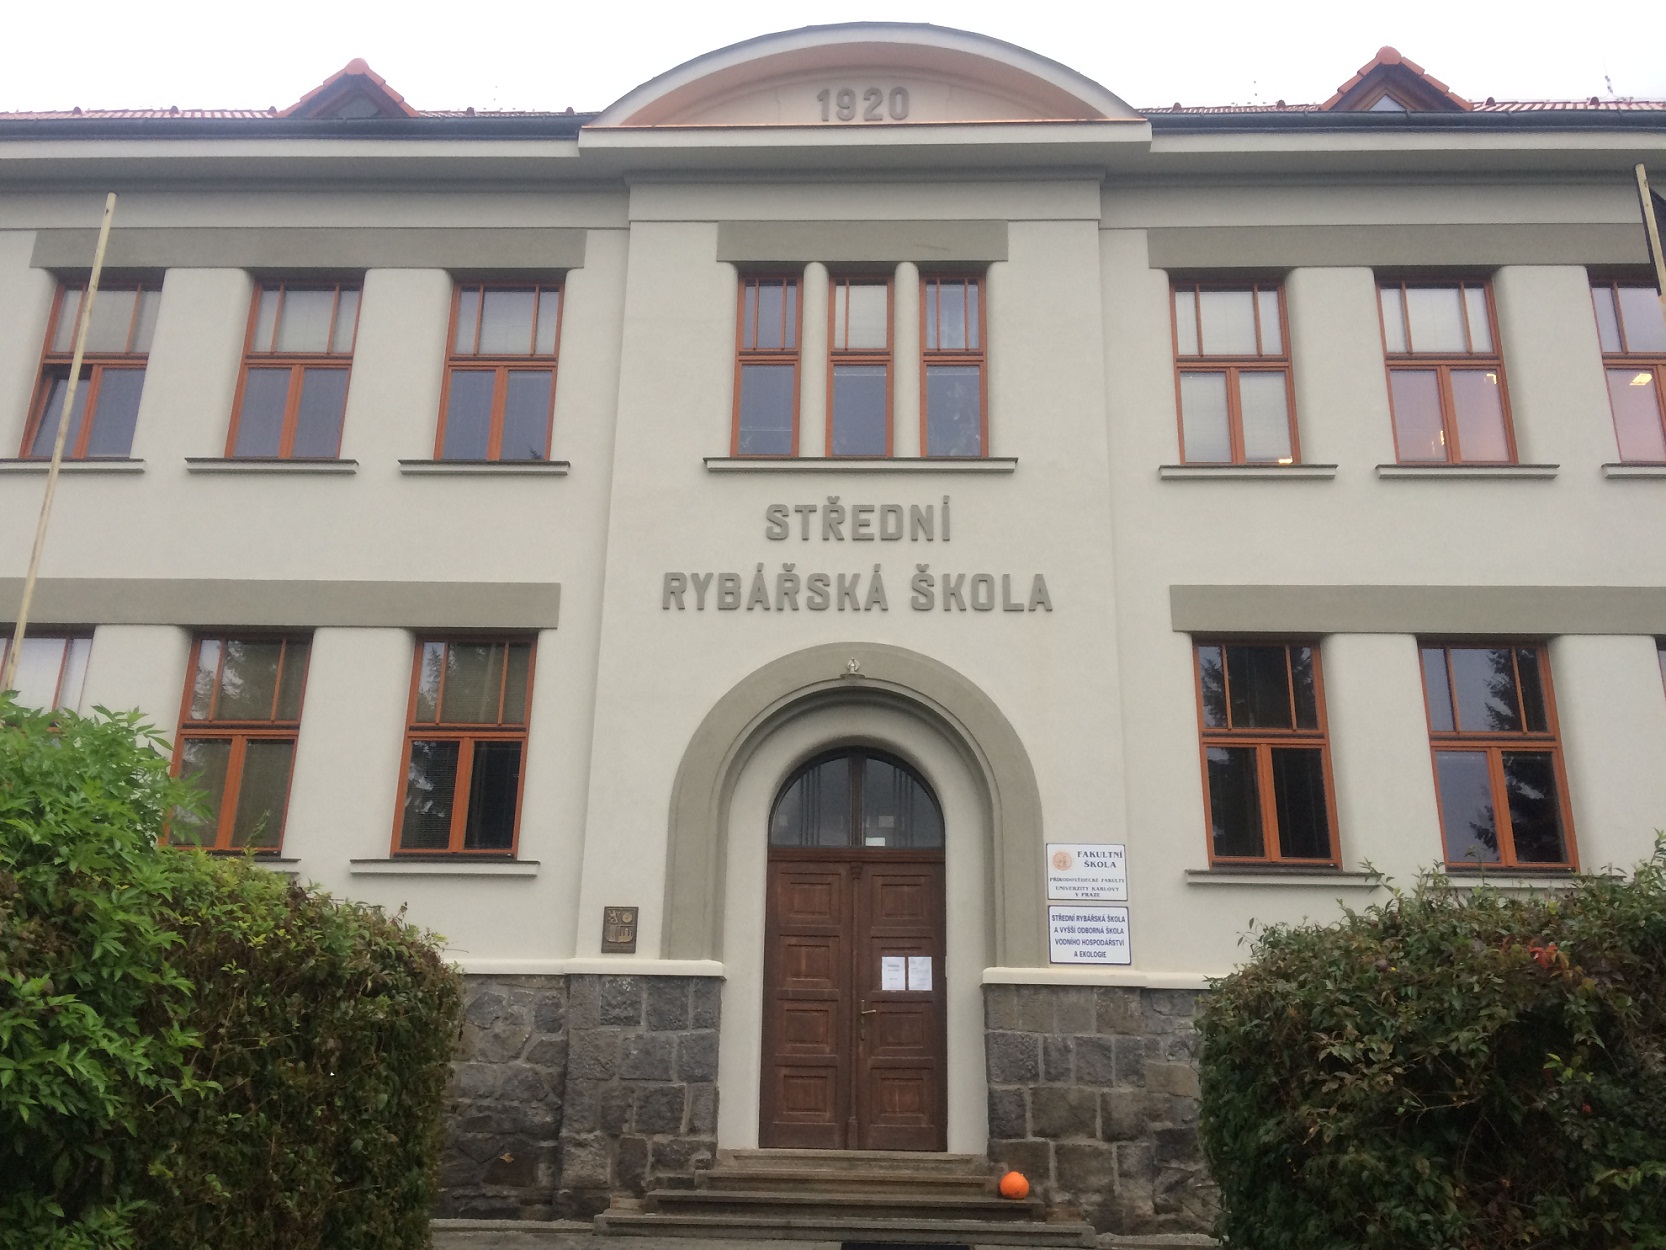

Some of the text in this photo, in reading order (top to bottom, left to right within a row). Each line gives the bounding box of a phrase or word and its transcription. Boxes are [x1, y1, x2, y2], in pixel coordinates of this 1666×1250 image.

[816, 86, 910, 122] 1920
[765, 495, 951, 541] STŘEDNÍ
[662, 562, 1053, 612] RYBÁŘSKÁ ŠKOLA
[1077, 850, 1123, 859] FAKULTNÍ
[1084, 860, 1117, 869] ŠKOLA
[1051, 913, 1126, 923] STŘEDNÍ RYBÁŘSKÁ ŠKOLA
[1060, 925, 1076, 934] VYŠŠÍ
[1077, 925, 1105, 934] ODBORNÁ
[1105, 926, 1125, 935] ŠKOLA
[1055, 937, 1125, 947] VODNÍHO HOSPODÁŘSTVÍ
